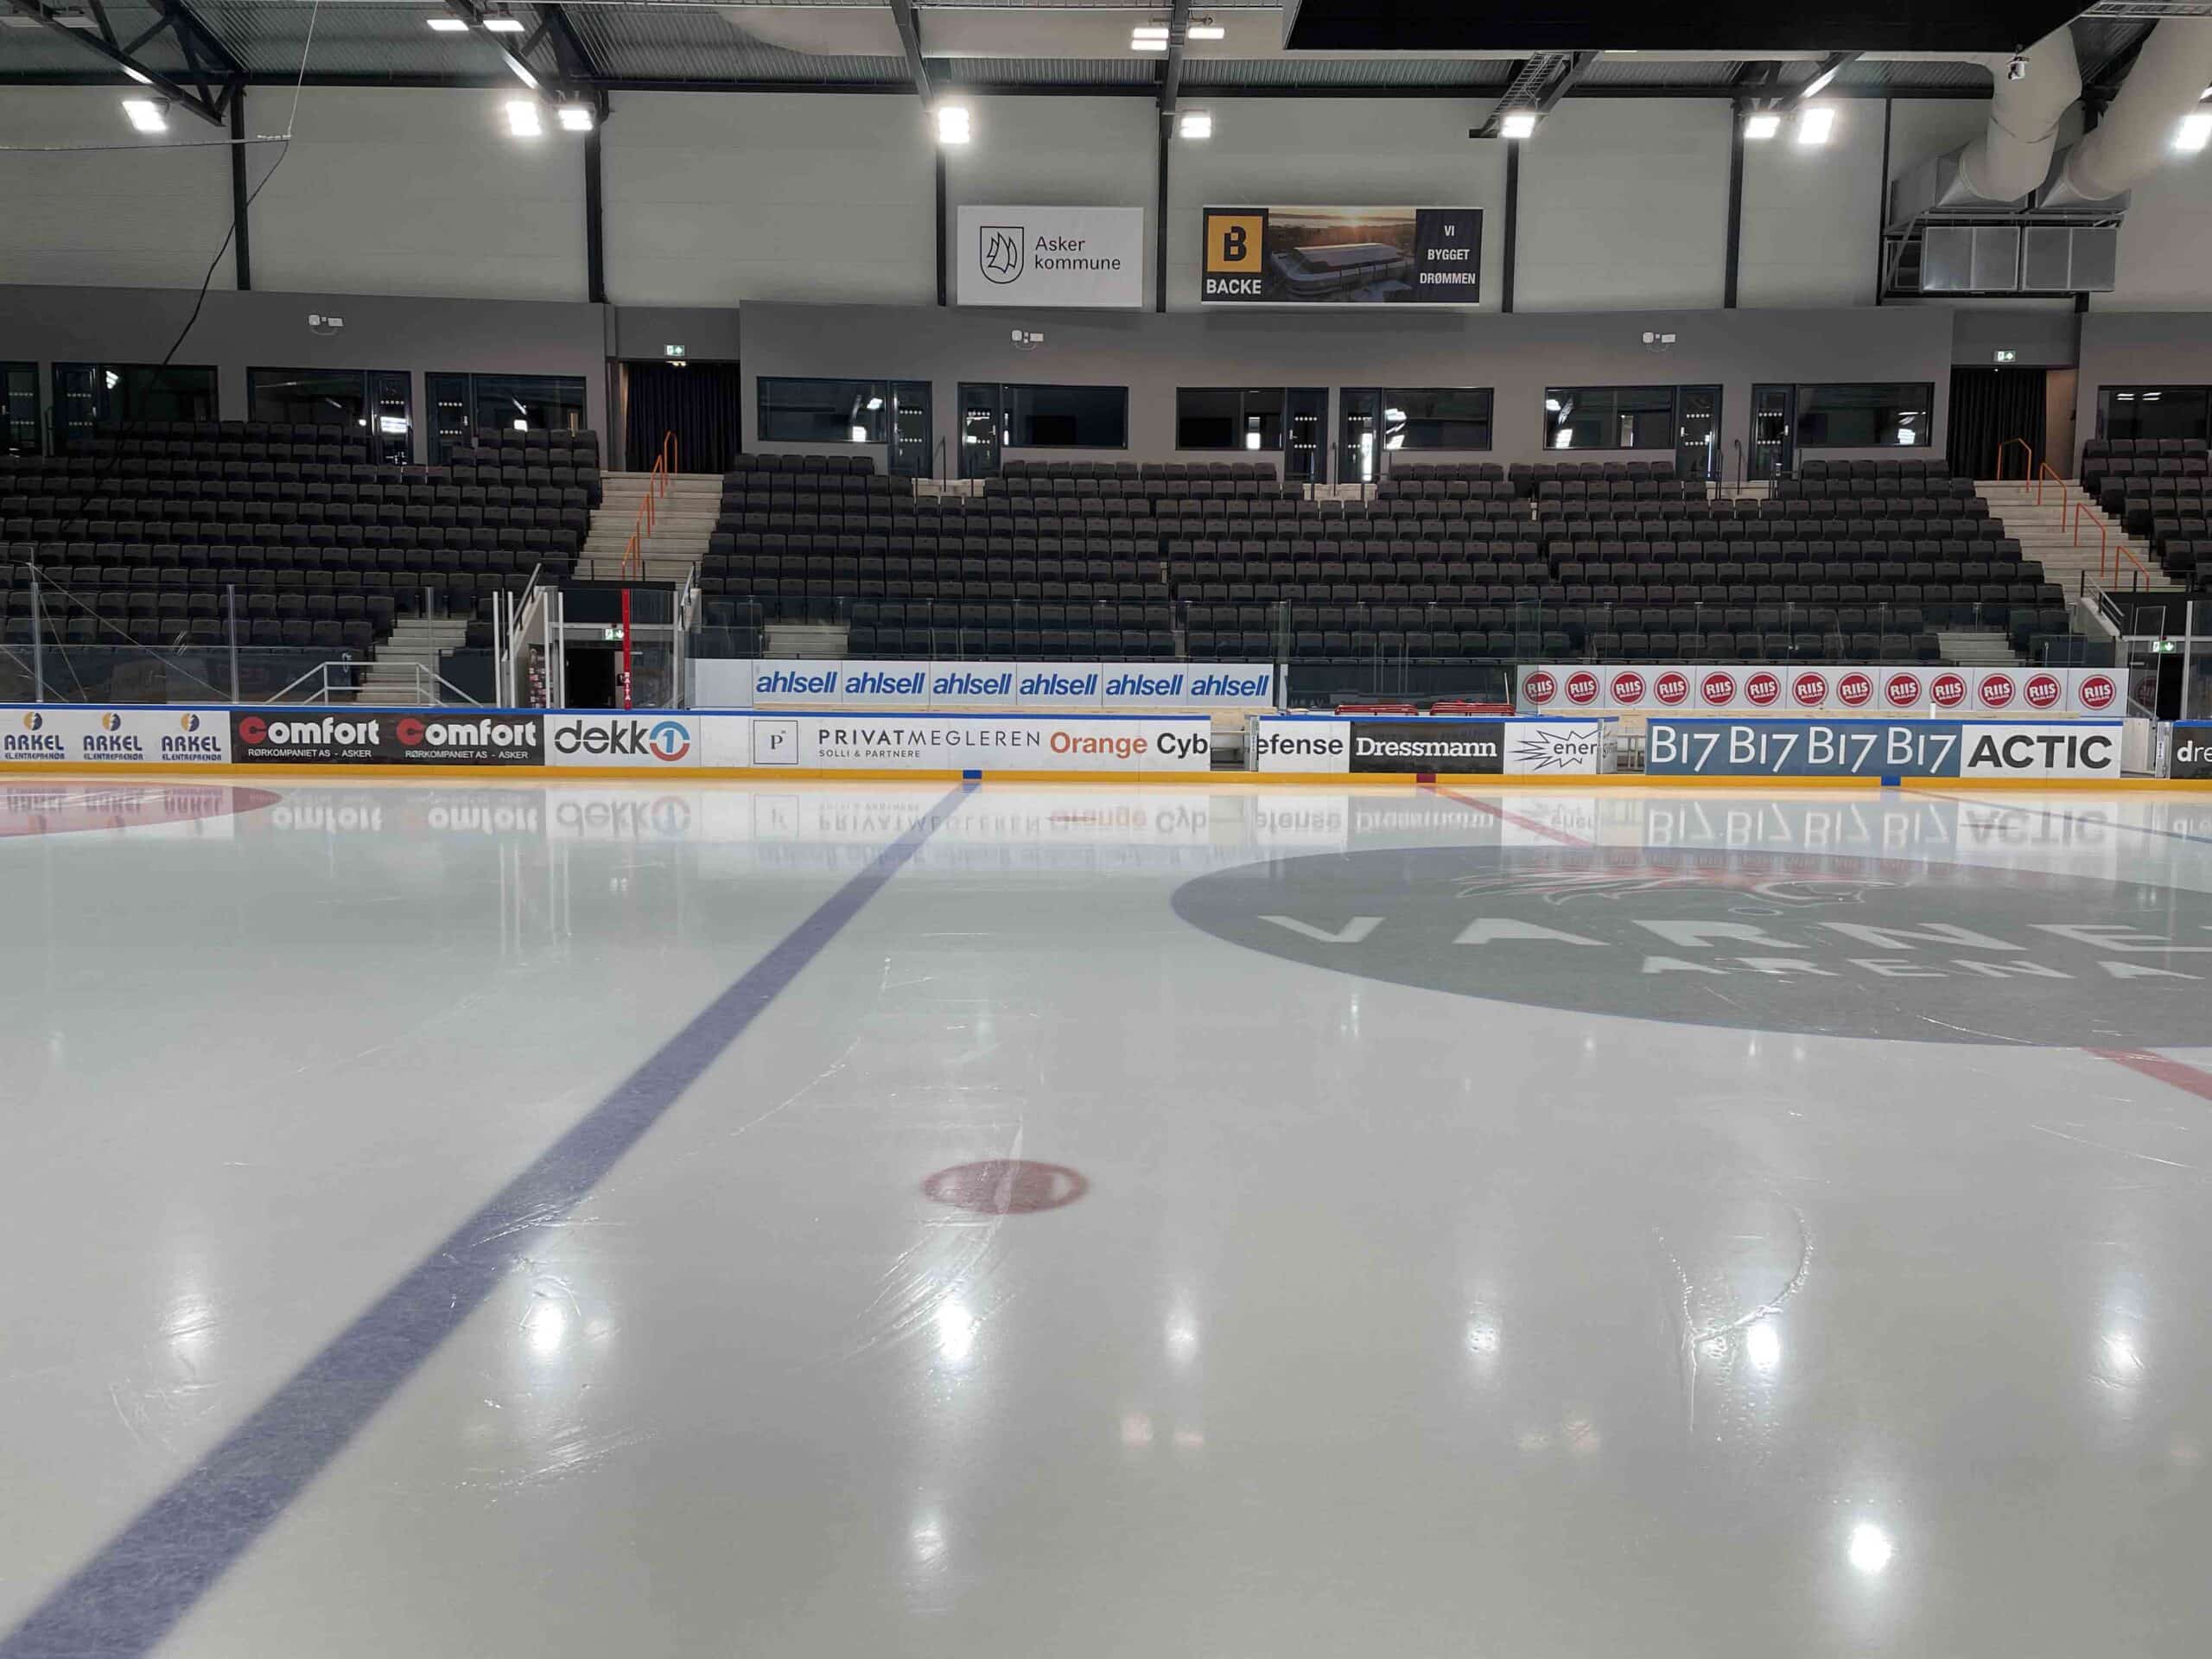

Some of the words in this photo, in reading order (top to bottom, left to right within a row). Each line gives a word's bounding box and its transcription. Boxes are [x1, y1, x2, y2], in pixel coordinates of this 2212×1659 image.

[1445, 225, 1455, 238] VI
[1035, 236, 1085, 251] Asker
[1224, 226, 1247, 261] B
[1035, 255, 1121, 271] kommune
[1427, 249, 1470, 262] BYGGET
[1419, 272, 1476, 285] DRØMMEN
[1206, 278, 1262, 295] BACKE
[756, 671, 837, 693] ahlsell
[845, 672, 925, 694] ahlsell
[933, 673, 1012, 695] ahlsell
[1020, 673, 1097, 696] ahlsell
[1106, 674, 1184, 696] ahlsell
[1191, 675, 1269, 696] ahlsell
[1527, 680, 1553, 695] RIIS
[1569, 680, 1595, 695] RIIS
[1615, 680, 1642, 695] RIIS
[1658, 681, 1685, 695] RIIS
[1706, 681, 1732, 696] RIIS
[1750, 681, 1776, 696] RIIS
[1797, 681, 1823, 696] RIIS
[1841, 682, 1869, 696] RIIS
[1890, 682, 1916, 696] RIIS
[1935, 682, 1962, 697] RIIS
[1983, 683, 2011, 697] RIIS
[2029, 683, 2056, 697] RIIS
[2084, 683, 2112, 698] RIIS
[239, 716, 380, 745] Comfort
[397, 718, 537, 747] Comfort
[819, 729, 1040, 747] PRIVATMEGLEREN
[4, 734, 64, 750] ARKEL
[84, 735, 142, 751] ARKEL
[162, 735, 221, 752] ARKEL
[1050, 732, 1147, 759] Orange
[1356, 737, 1497, 757] Dressmann
[248, 748, 317, 758] RØRKOMPANIET
[318, 749, 331, 758] AS
[341, 749, 372, 758] ASKER
[405, 750, 474, 760] RØRKOMPANIET
[475, 751, 487, 760] AS
[499, 751, 528, 760] ASKER
[1967, 734, 2113, 769] ACTIC
[1258, 914, 2212, 952] VARNE
[1643, 955, 2207, 981] ARENA
